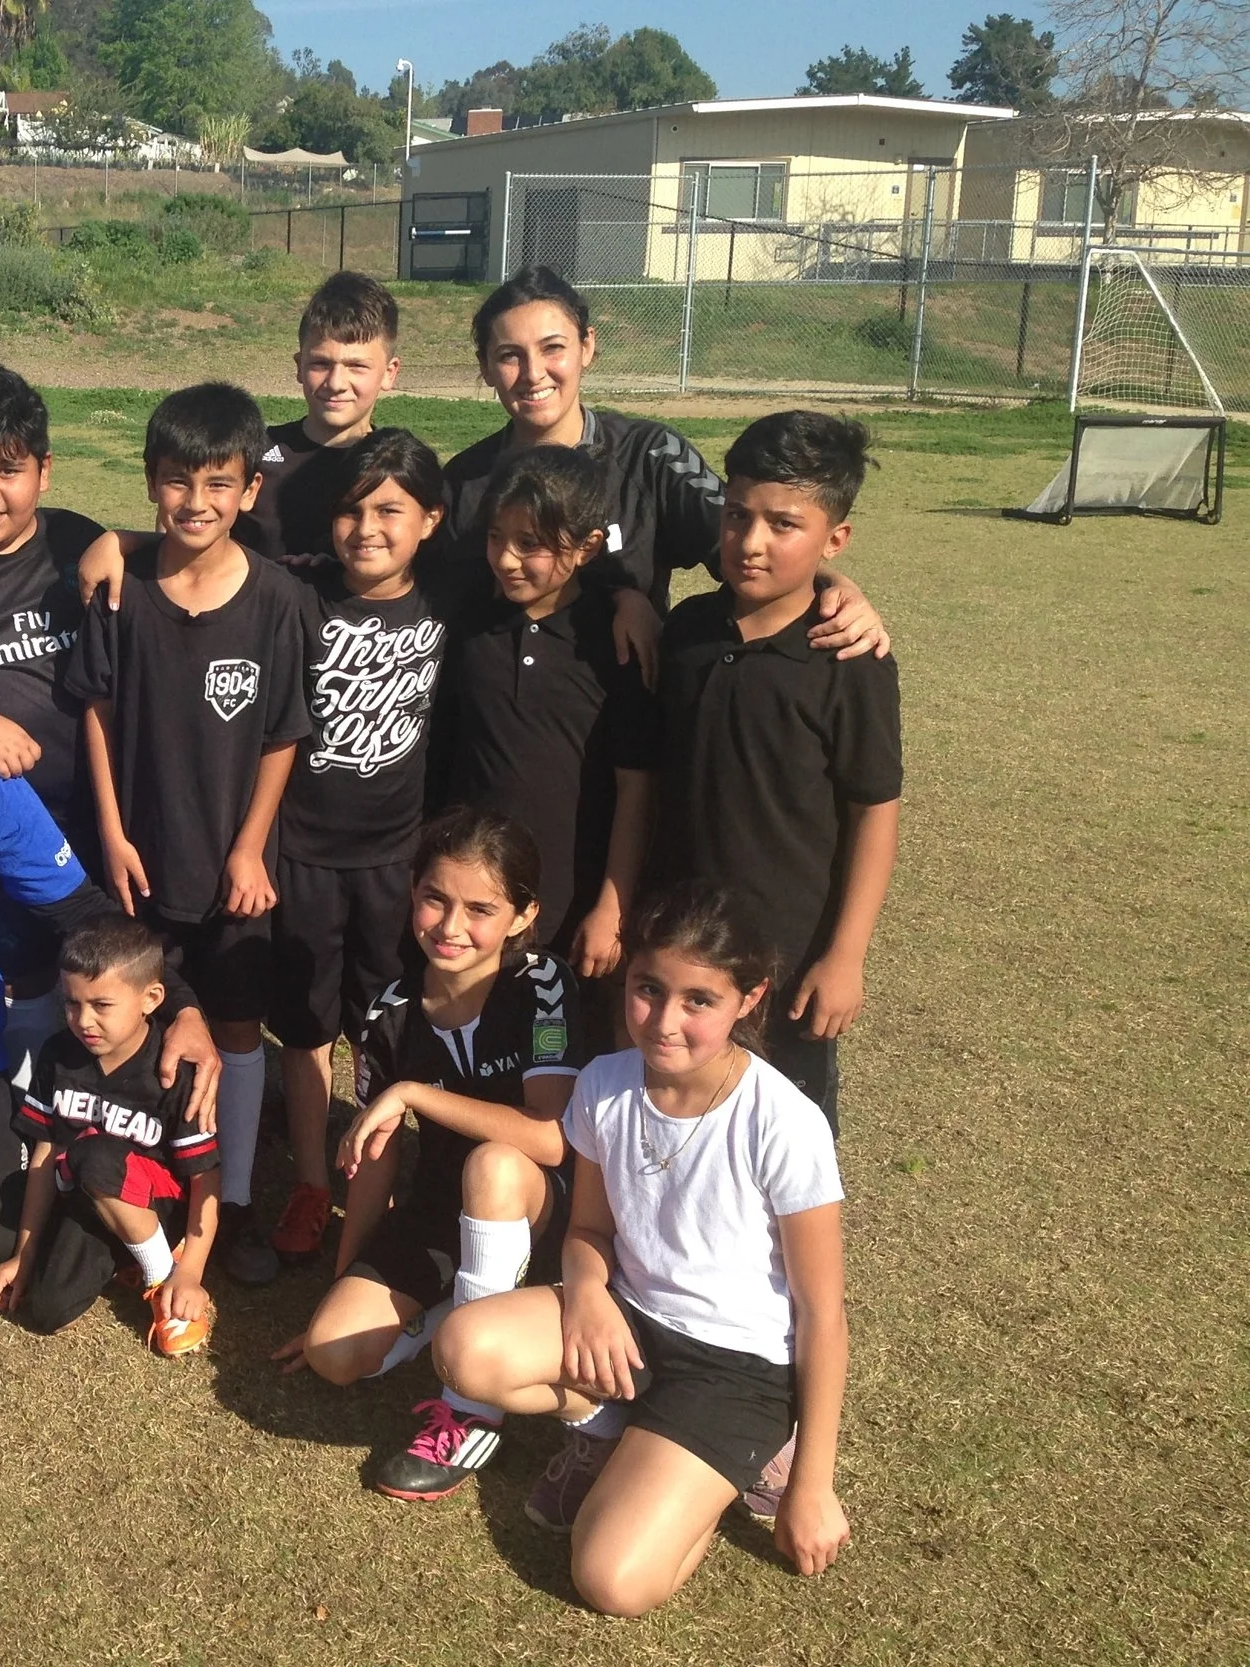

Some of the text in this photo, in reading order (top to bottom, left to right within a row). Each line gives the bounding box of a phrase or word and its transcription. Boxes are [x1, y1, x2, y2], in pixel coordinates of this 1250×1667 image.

[13, 610, 50, 632] Fly
[310, 617, 443, 671] Three
[208, 671, 256, 698] 1904
[223, 698, 237, 708] FC
